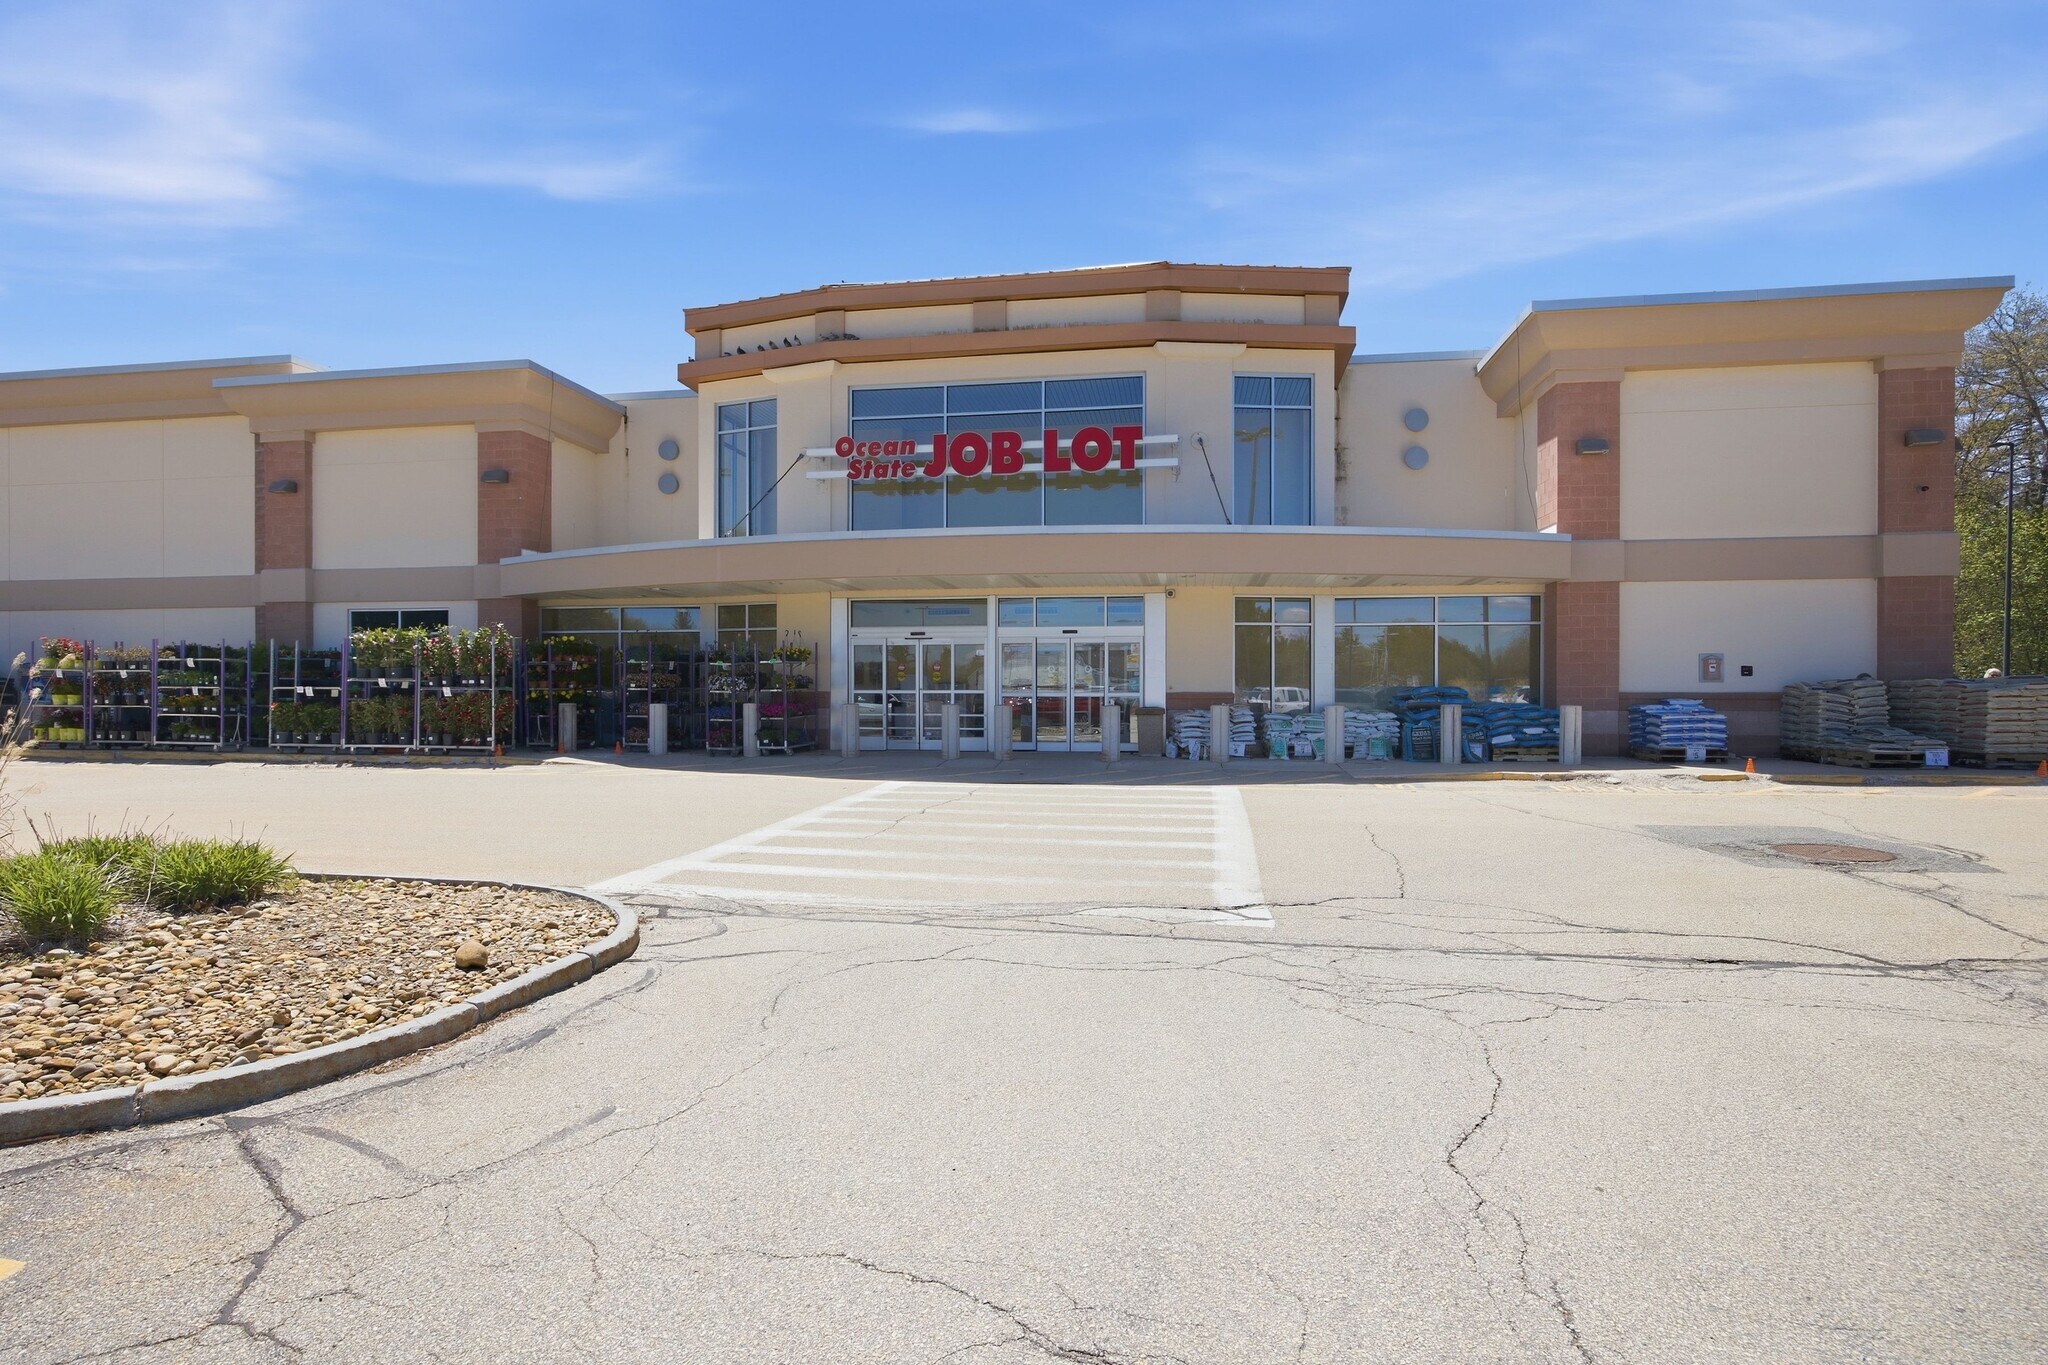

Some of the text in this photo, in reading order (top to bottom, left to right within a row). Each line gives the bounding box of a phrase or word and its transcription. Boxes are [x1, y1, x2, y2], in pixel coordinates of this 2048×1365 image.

[834, 436, 917, 458] Ocean
[922, 425, 1144, 478] JOB LOT
[846, 459, 917, 480] State
